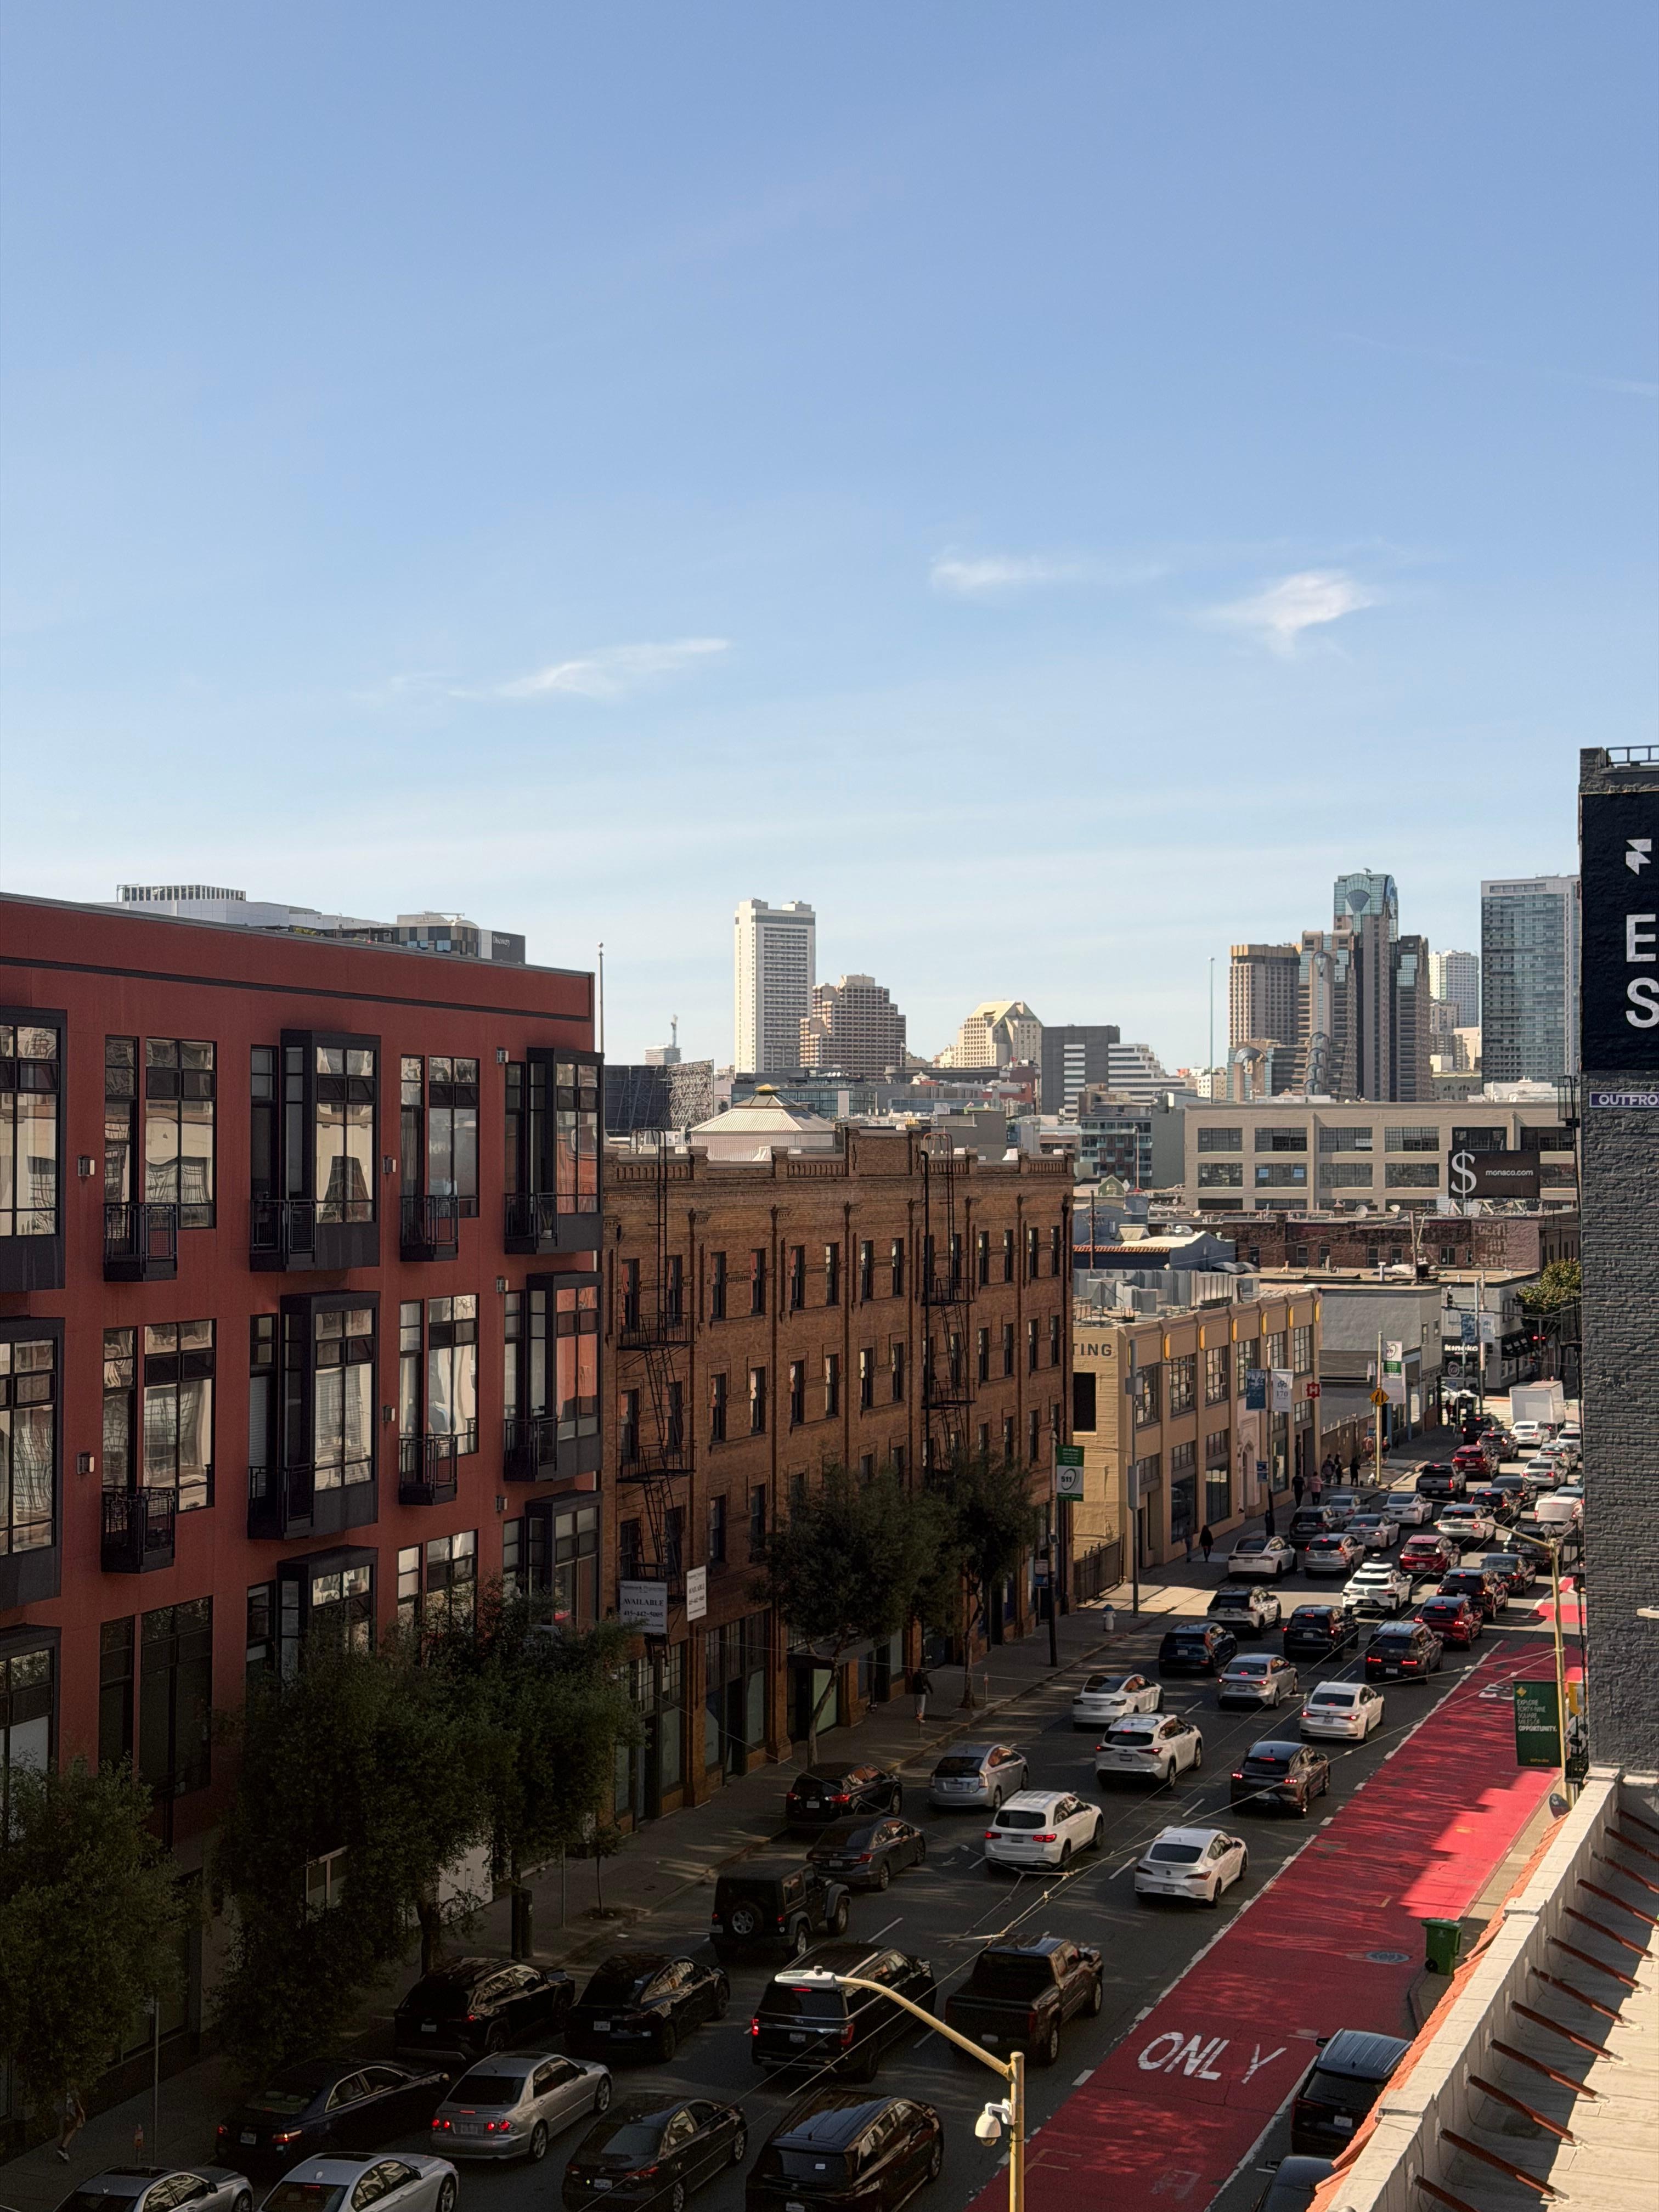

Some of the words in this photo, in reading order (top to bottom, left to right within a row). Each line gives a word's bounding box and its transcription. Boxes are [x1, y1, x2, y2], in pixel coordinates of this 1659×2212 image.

[1599, 1094, 1659, 1105] OUTFRO
[623, 1598, 664, 1607] AVAILABLE
[1137, 2032, 1287, 2085] ONLY
